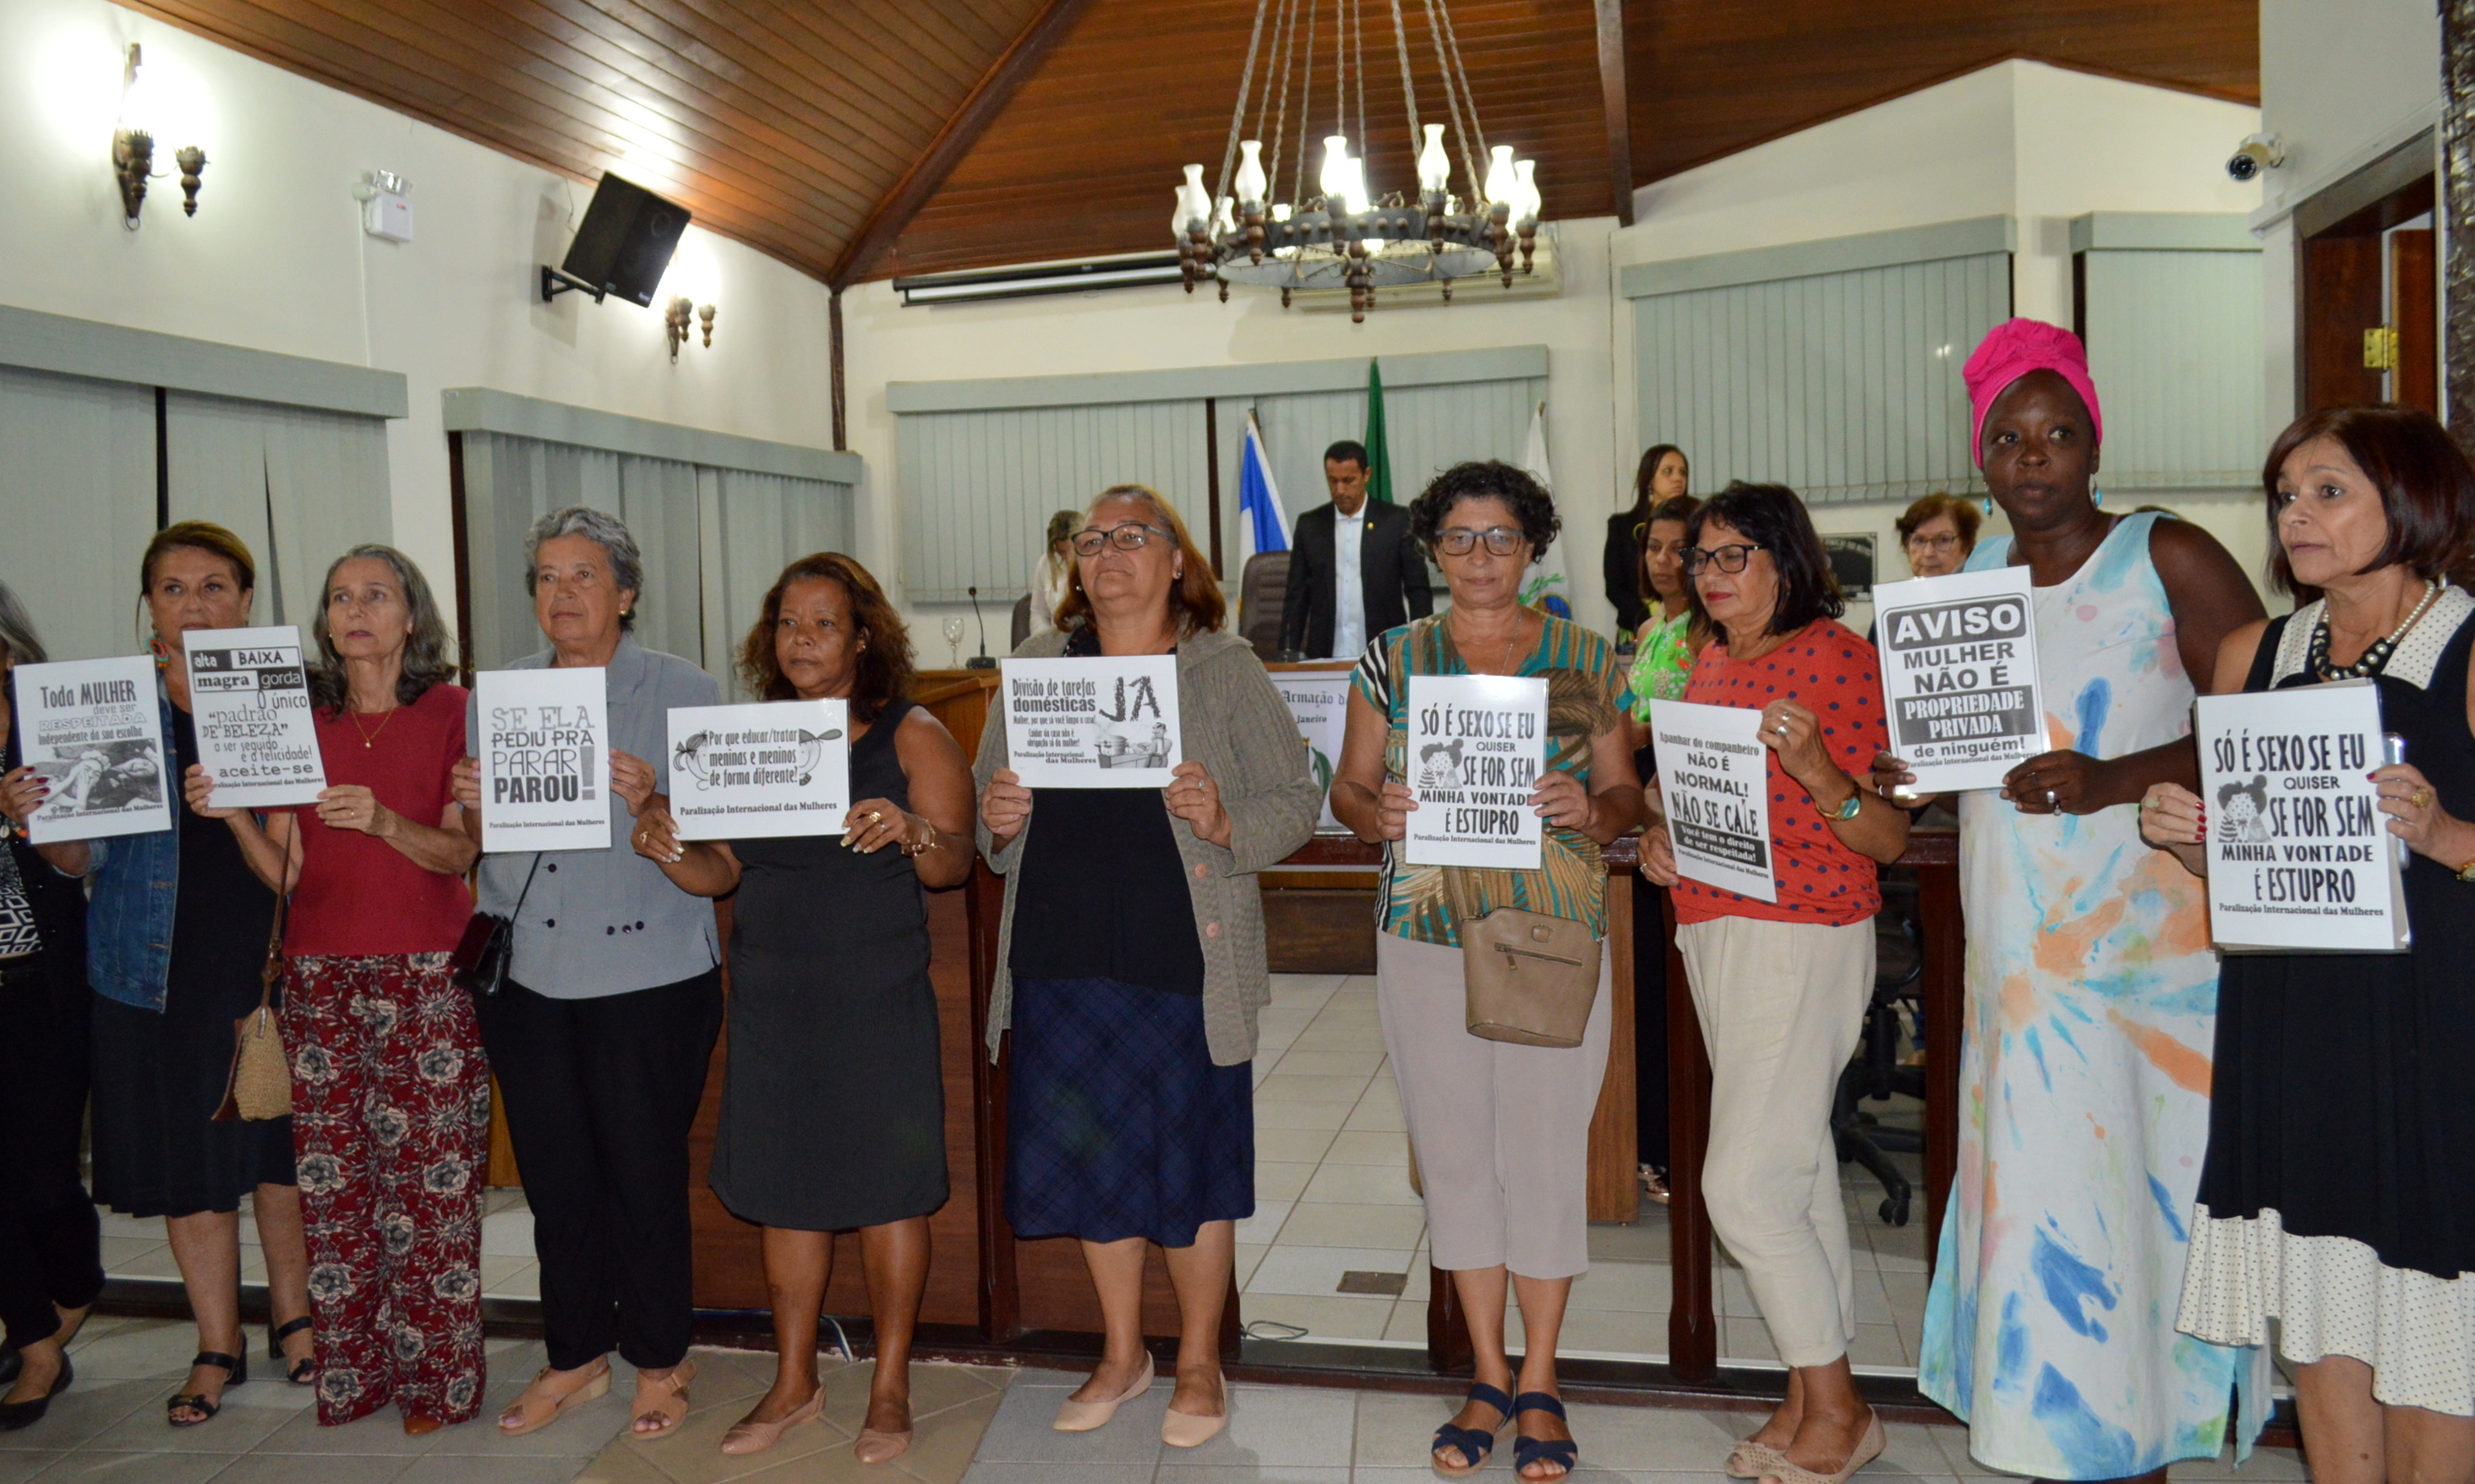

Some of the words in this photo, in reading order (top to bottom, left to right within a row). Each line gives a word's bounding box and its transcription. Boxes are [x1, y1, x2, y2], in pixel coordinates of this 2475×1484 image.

[1895, 603, 2020, 644] AVISO
[194, 653, 218, 668] alta
[238, 651, 284, 665] BAIXA
[1904, 641, 2014, 669] MULHER
[198, 676, 249, 689] magra
[261, 671, 301, 689] gorda
[1915, 667, 1978, 694] NÃO
[1990, 661, 2008, 685] É
[40, 685, 74, 708] Toda
[81, 679, 137, 705] MULHER
[1013, 679, 1044, 696] Divisão
[1047, 678, 1058, 696] de
[1063, 678, 1095, 697] tarefas
[272, 692, 308, 709] único
[1013, 697, 1095, 712] domésticas
[1281, 690, 1333, 707] Armação
[1904, 690, 2024, 719] PROPRIEDADE
[93, 704, 117, 715] deve
[120, 703, 136, 712] ser
[491, 707, 527, 731] SE
[538, 706, 595, 730] ELA
[39, 712, 146, 732] RESPEITADA
[1049, 715, 1053, 723] só
[1055, 715, 1064, 723] você
[1066, 716, 1079, 725] limpa
[1297, 715, 1327, 724] Janeiro
[1421, 702, 1440, 735] SÓ
[1445, 703, 1452, 736] É
[1458, 710, 1494, 737] SEXO
[1496, 712, 1512, 739] SE
[1518, 712, 1535, 739] EU
[1929, 714, 2002, 739] PRIVADA
[38, 731, 88, 745] Independente
[90, 729, 100, 741] da
[101, 729, 113, 740] sua
[117, 725, 142, 739] escolha
[203, 725, 218, 739] DE
[491, 731, 545, 748] PEDIU
[552, 730, 594, 745] PRA
[709, 731, 722, 745] Por
[725, 732, 739, 746] que
[742, 728, 796, 744] educar/tratar
[1029, 728, 1042, 737] Cuidar
[1044, 728, 1049, 737] da
[1062, 728, 1070, 737] não
[1072, 728, 1074, 737] é
[224, 742, 236, 751] ser
[241, 735, 277, 753] seguido
[1028, 738, 1047, 748] obrigação
[1049, 739, 1053, 747] só
[1055, 739, 1061, 747] da
[1063, 738, 1079, 747] mulher!
[1476, 741, 1516, 752] QUISER
[1660, 732, 1691, 746] Apanhar
[1693, 737, 1702, 747] do
[1705, 740, 1759, 756] companheiro
[1914, 745, 1934, 757] de
[1941, 736, 2024, 757] ninguém!
[2214, 729, 2235, 772] SÓ
[2243, 728, 2251, 772] É
[2257, 735, 2304, 772] SEXO
[2308, 735, 2330, 771] SE
[2339, 734, 2365, 770] EU
[260, 745, 313, 761] felicidade!
[493, 749, 576, 776] PARAR
[709, 749, 747, 767] meninas
[751, 752, 756, 764] e
[759, 746, 796, 764] meninos
[1687, 752, 1718, 769] NÃO
[1723, 756, 1729, 771] É
[219, 764, 313, 777] aceite-se
[710, 769, 720, 786] de
[724, 769, 750, 788] forma
[1463, 756, 1477, 786] SE
[1481, 756, 1505, 787] FOR
[1511, 757, 1535, 788] SEM
[1675, 770, 1749, 797] NORMAL!
[2284, 776, 2341, 790] QUISER
[1419, 789, 1465, 803] MINHA
[37, 812, 74, 821] Paralização
[76, 808, 120, 816] Internacional
[134, 803, 163, 811] Mulheres
[680, 806, 724, 816] Paralização
[727, 804, 782, 813] Internacional
[800, 802, 837, 810] Mulheres
[1671, 789, 1701, 823] NÃO
[1704, 799, 1720, 828] SE
[1724, 799, 1758, 837] CALE
[2270, 797, 2288, 837] SE
[2294, 796, 2330, 837] FOR
[2335, 795, 2375, 837] SEM
[1445, 808, 1451, 832] É
[1456, 808, 1518, 835] ESTUPRO
[1681, 825, 1700, 837] Você
[1702, 831, 1718, 841] tem
[1727, 837, 1755, 851] direito
[1684, 836, 1693, 845] de
[1696, 840, 1708, 849] ser
[1710, 843, 1757, 862] respeitada!
[2221, 845, 2276, 861] MINHA
[2283, 845, 2374, 862] VONTADE
[1678, 848, 1702, 860] Paralização
[1704, 856, 1735, 870] Internacional
[1746, 868, 1768, 879] Mulheres
[2254, 868, 2262, 901] É
[2267, 868, 2355, 903] ESTUPRO
[2219, 903, 2262, 914] Paralização
[2264, 905, 2320, 914] Internacional
[2323, 907, 2337, 915] das
[2341, 907, 2383, 916] Mulheres
